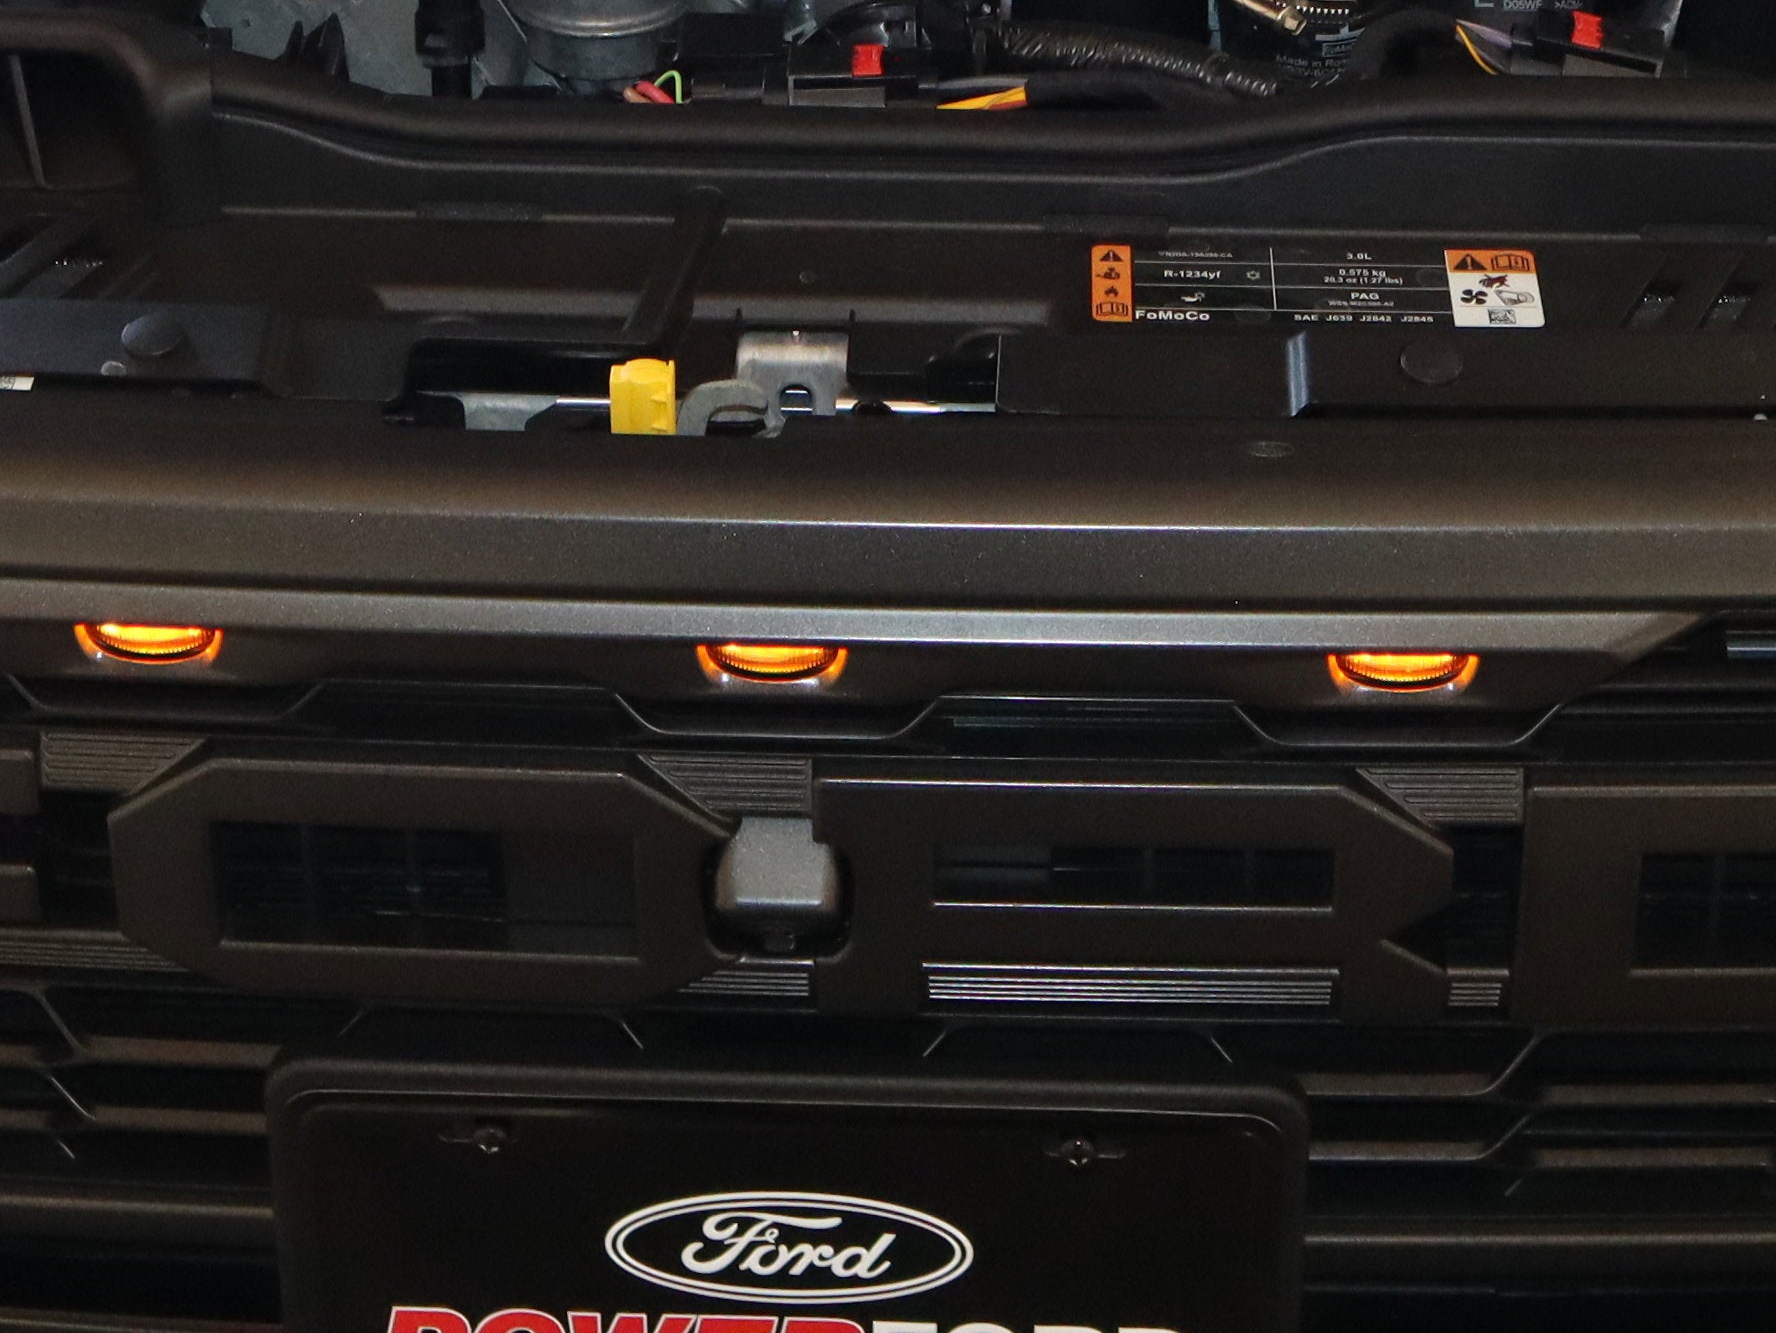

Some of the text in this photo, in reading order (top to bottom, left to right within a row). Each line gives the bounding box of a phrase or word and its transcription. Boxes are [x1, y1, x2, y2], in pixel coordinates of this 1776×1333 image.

[1275, 54, 1309, 66] Made
[1345, 252, 1373, 261] 3.0L
[1163, 269, 1222, 281] R-1234yf
[1371, 269, 1387, 278] kg
[1350, 292, 1381, 301] PAG
[1135, 310, 1211, 321] FoMoCo
[1293, 314, 1320, 323] SAE
[681, 1211, 895, 1281] Ford
